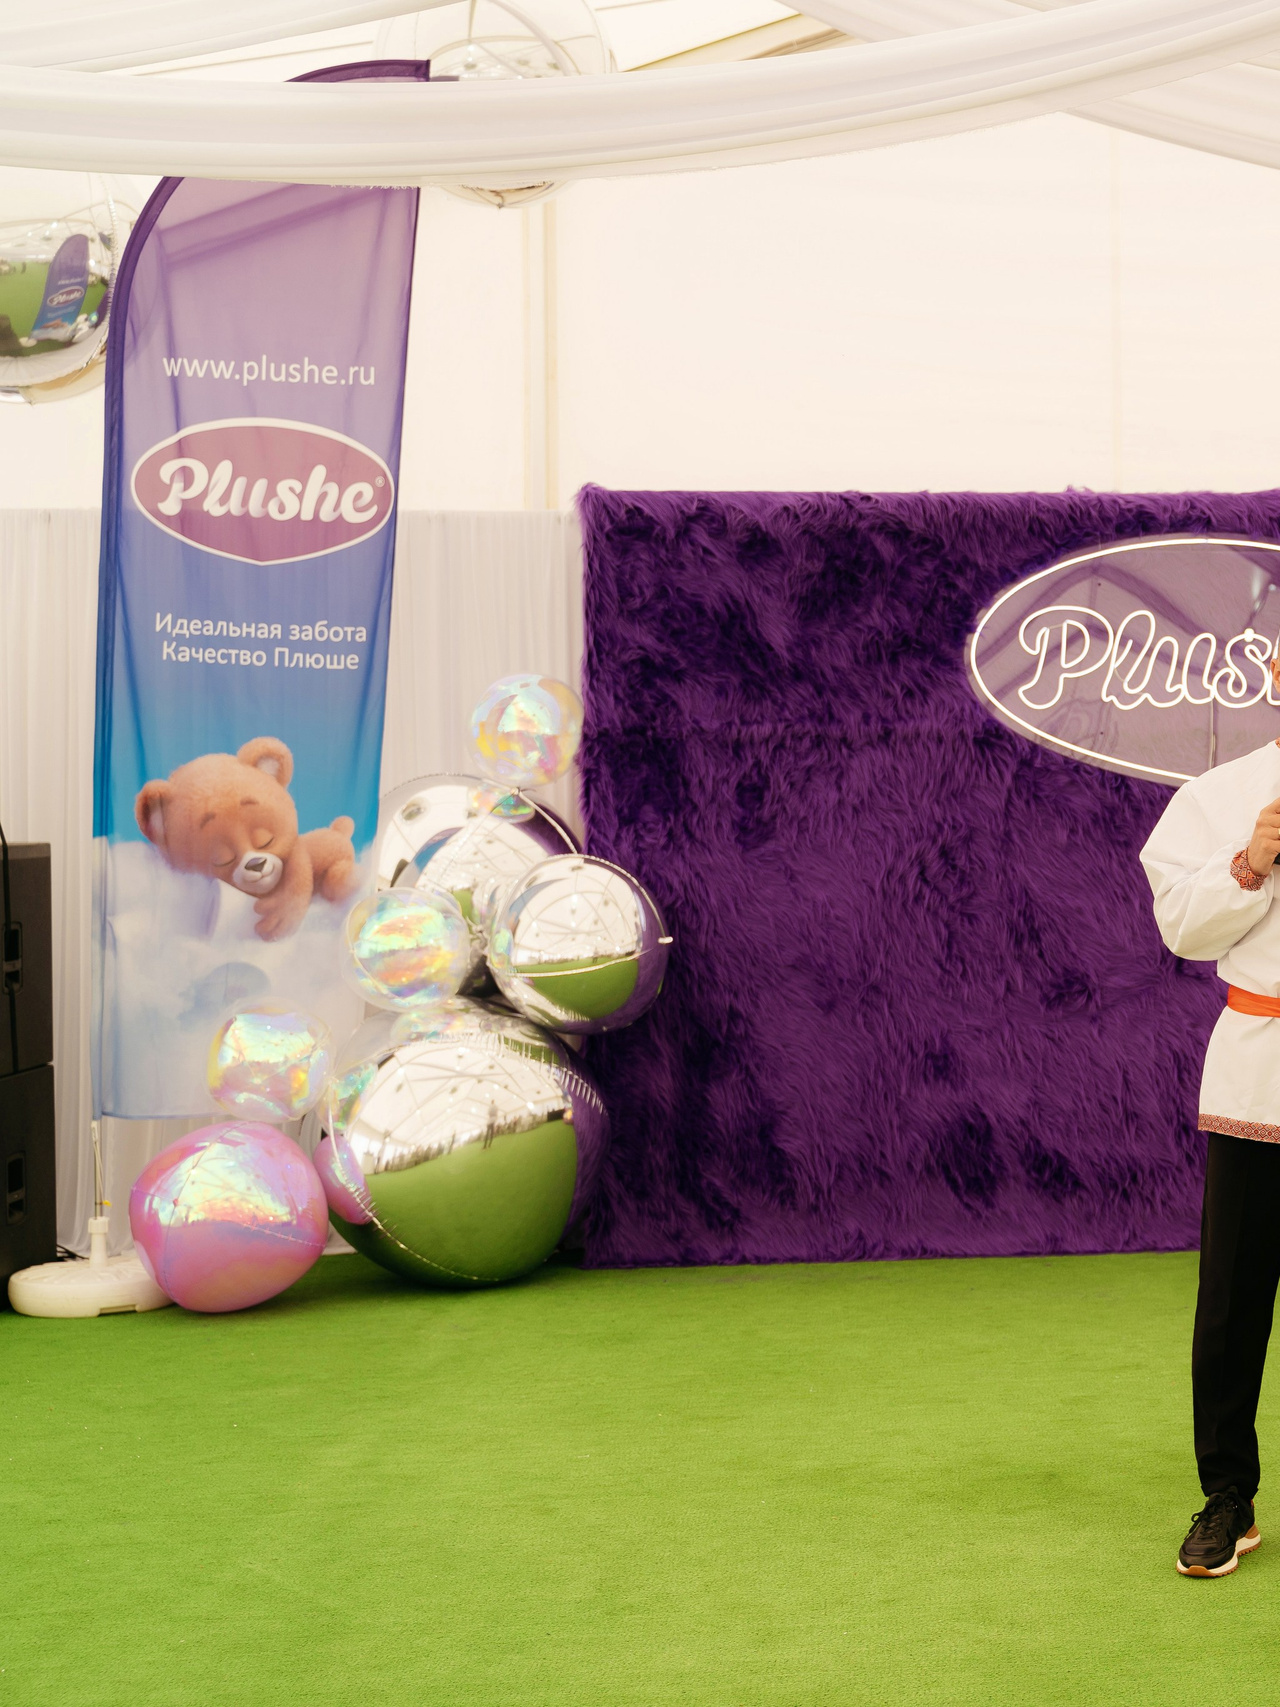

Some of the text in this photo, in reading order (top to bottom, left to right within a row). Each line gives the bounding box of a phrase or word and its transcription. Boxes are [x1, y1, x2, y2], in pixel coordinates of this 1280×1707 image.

[162, 354, 376, 386] www.plushe.ru
[157, 458, 378, 524] Plushe
[155, 612, 367, 642] Идеальная забота
[162, 641, 360, 669] Качество Плюше
